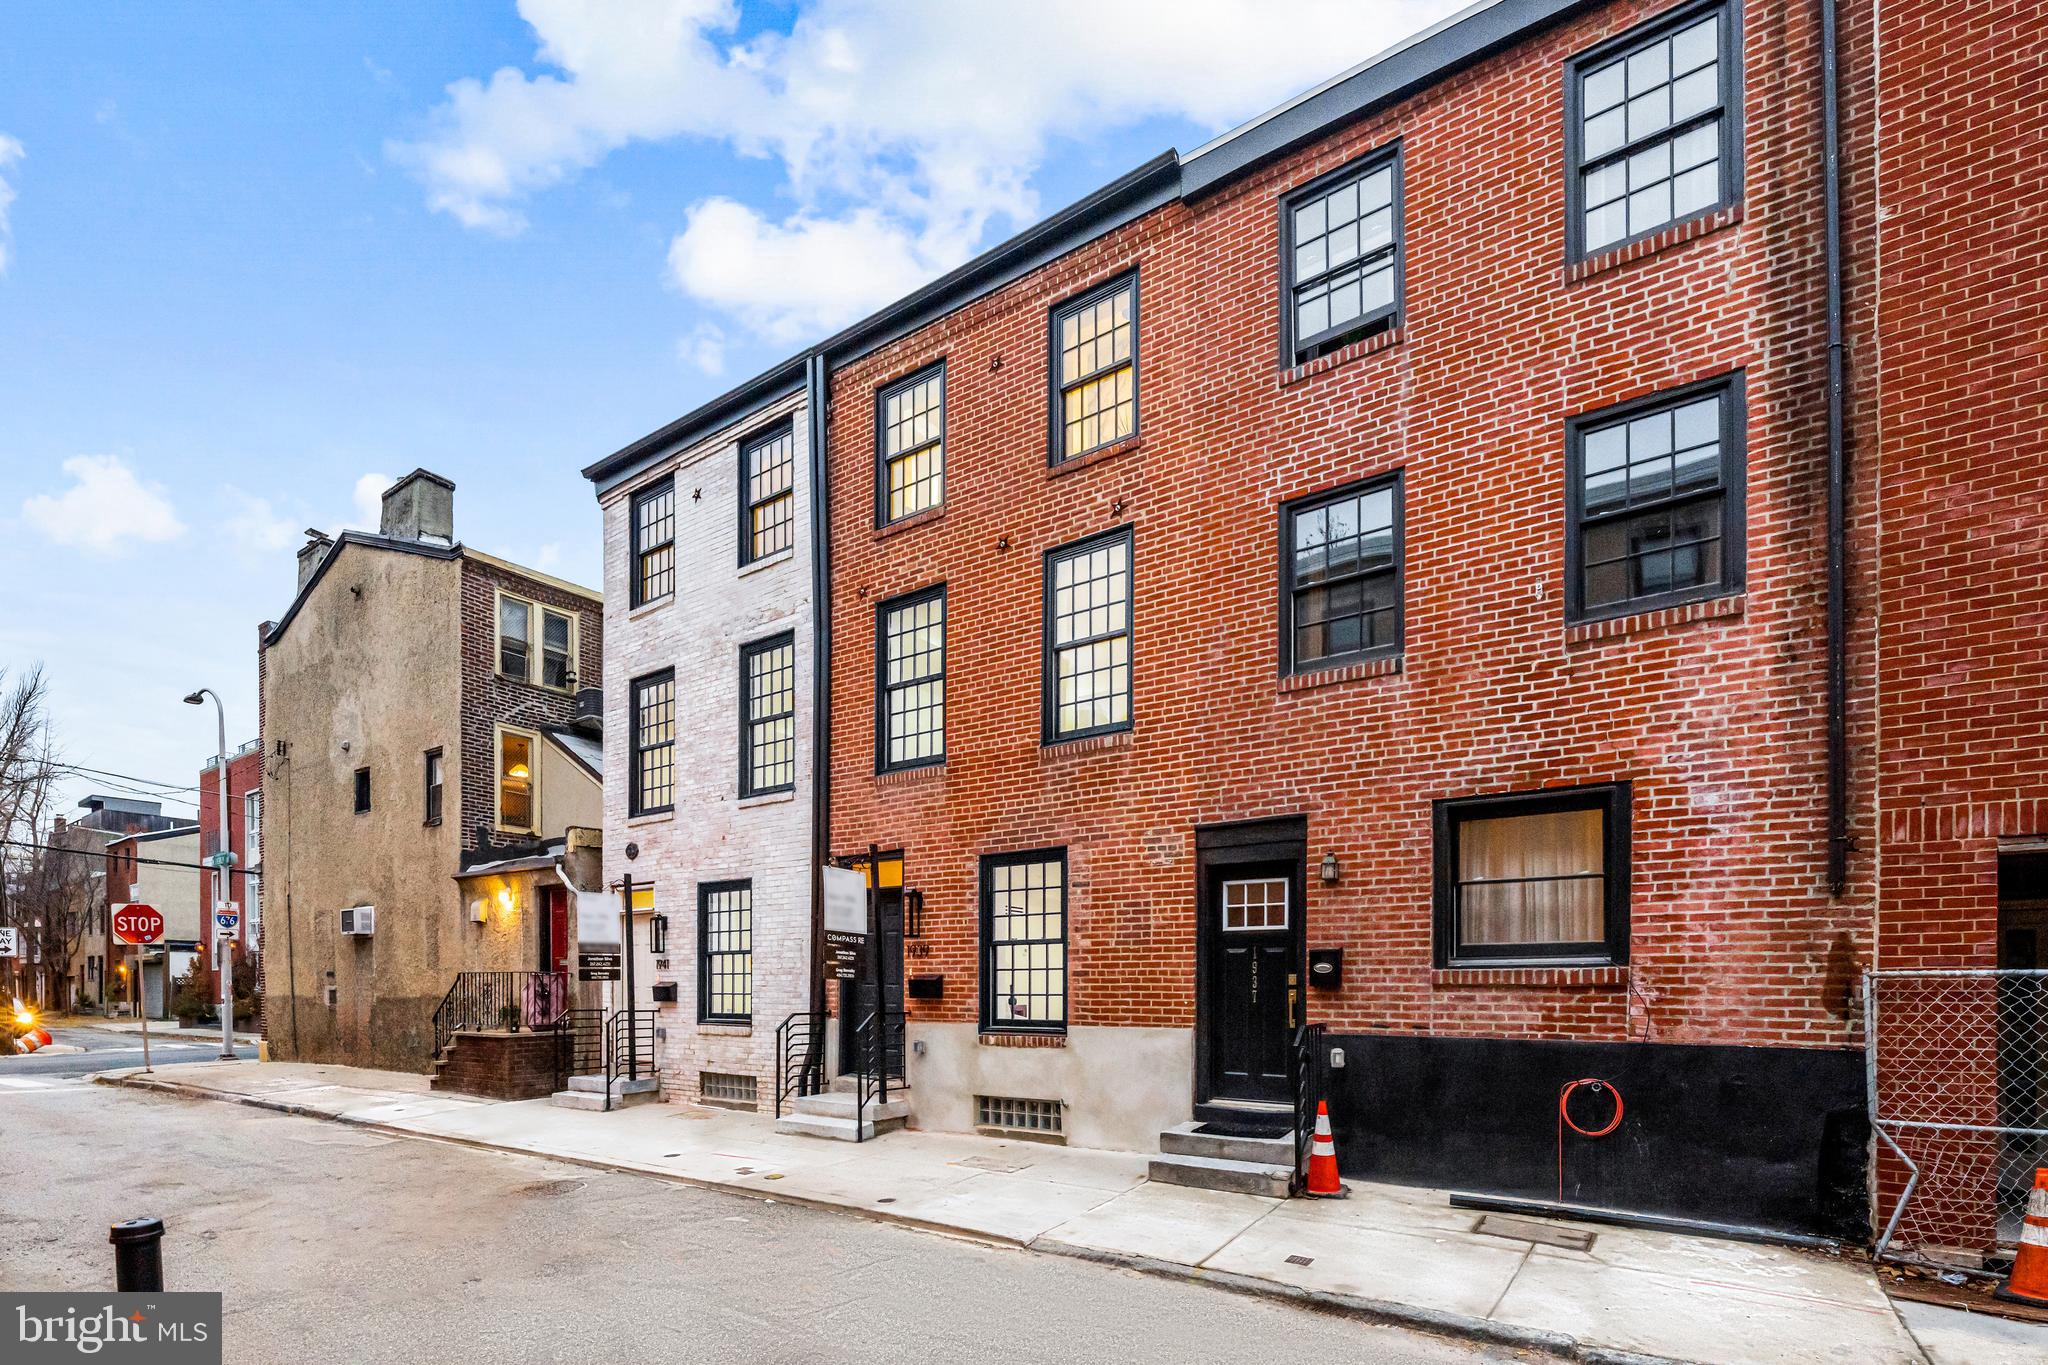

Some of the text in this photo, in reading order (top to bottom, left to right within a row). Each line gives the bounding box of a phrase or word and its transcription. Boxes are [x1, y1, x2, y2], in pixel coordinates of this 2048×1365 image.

[117, 916, 161, 932] STOP
[221, 915, 235, 925] 676
[827, 934, 857, 943] COMPASS
[907, 944, 930, 958] 1939
